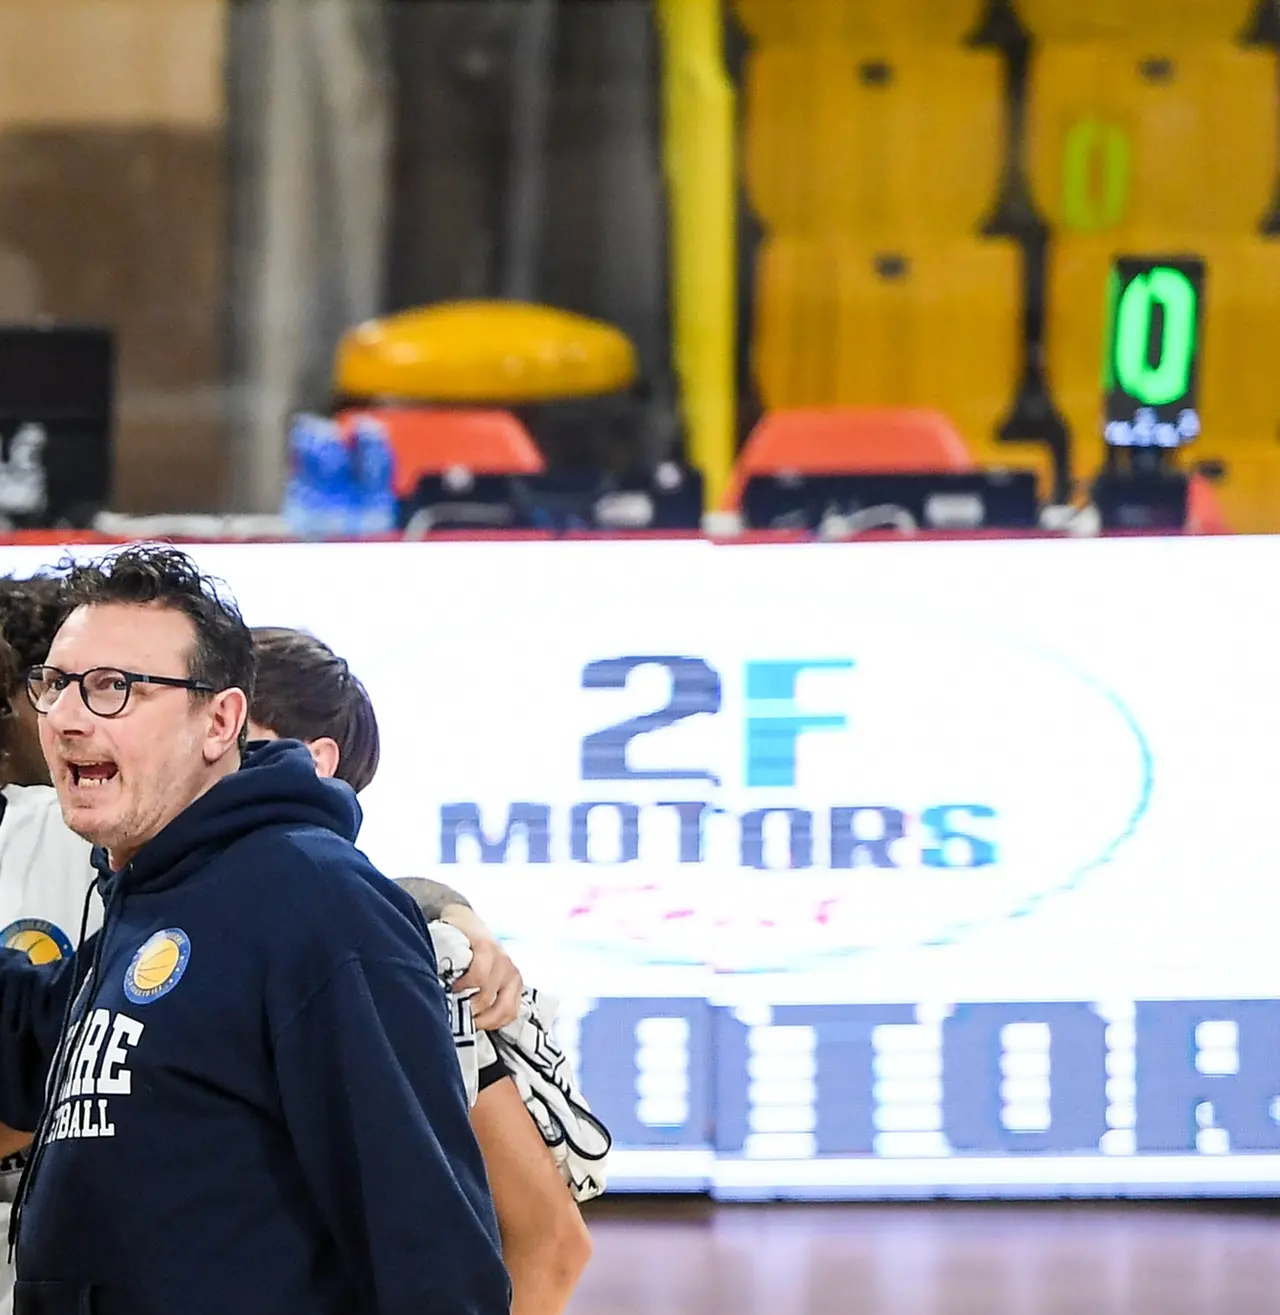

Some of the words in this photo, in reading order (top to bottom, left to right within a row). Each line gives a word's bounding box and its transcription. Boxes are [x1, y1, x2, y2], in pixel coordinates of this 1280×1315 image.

[1115, 265, 1198, 405] 0
[581, 655, 854, 788] 2F
[439, 800, 999, 870] MOTORS
